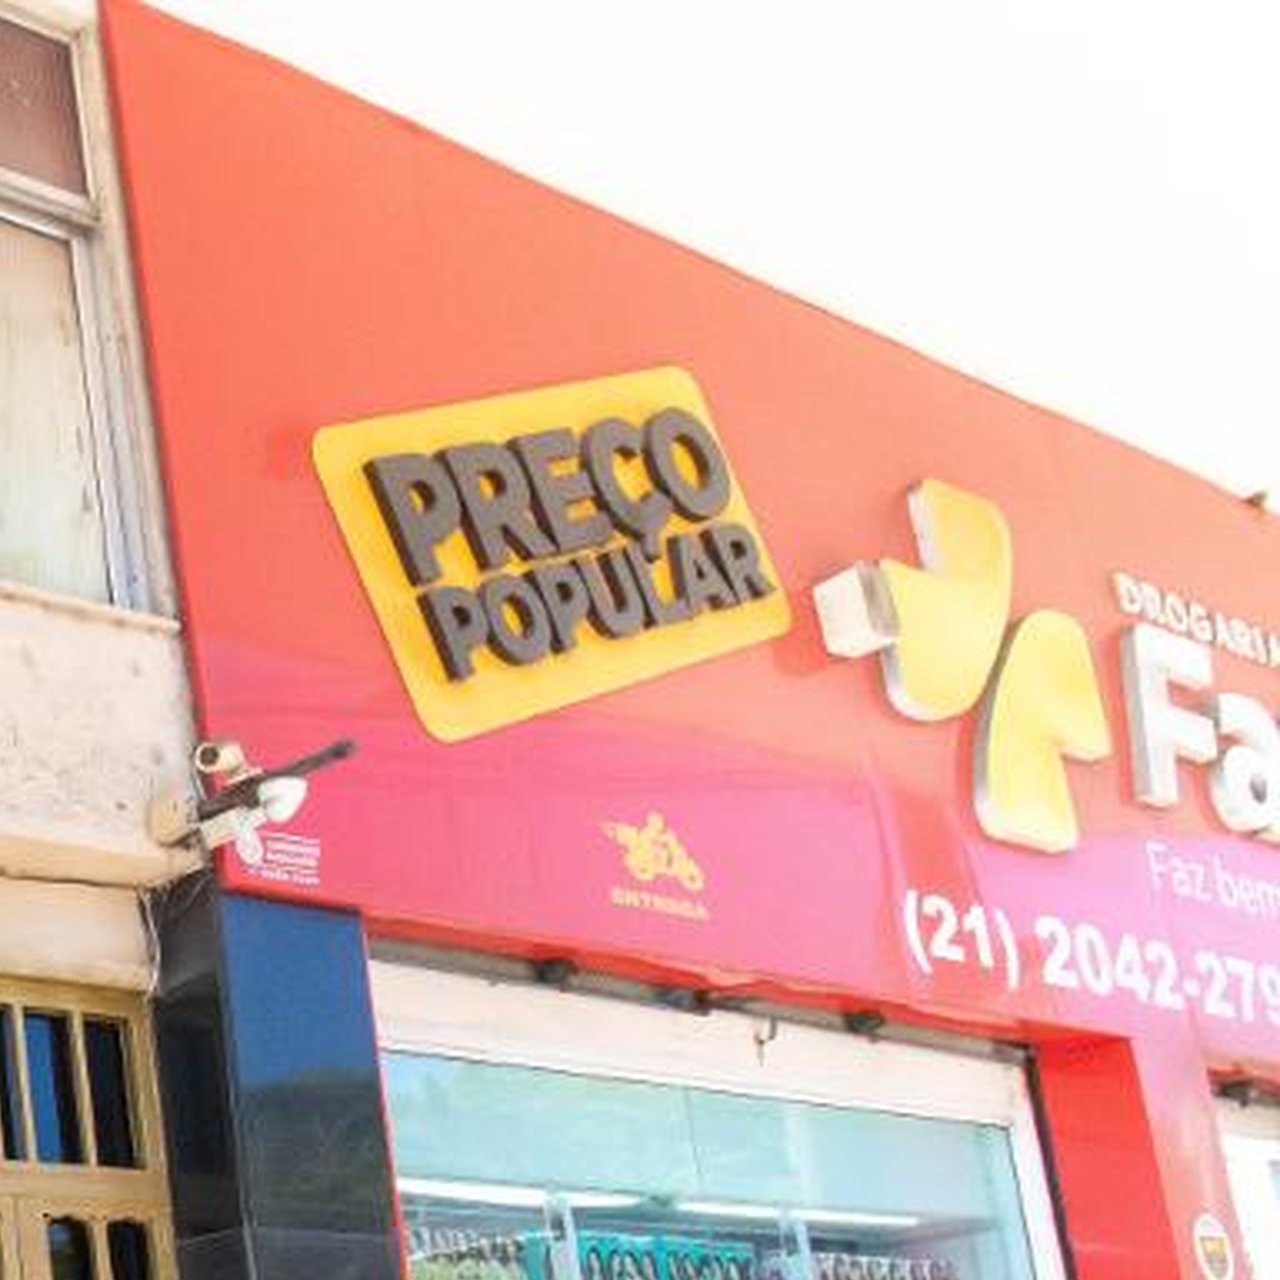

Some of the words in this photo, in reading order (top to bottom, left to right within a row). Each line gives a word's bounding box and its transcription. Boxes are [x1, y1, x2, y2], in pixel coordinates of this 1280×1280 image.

[363, 407, 732, 587] PREÇO
[416, 522, 777, 684] POPULAR
[1146, 840, 1214, 902] Faz
[904, 889, 1021, 992] (21)
